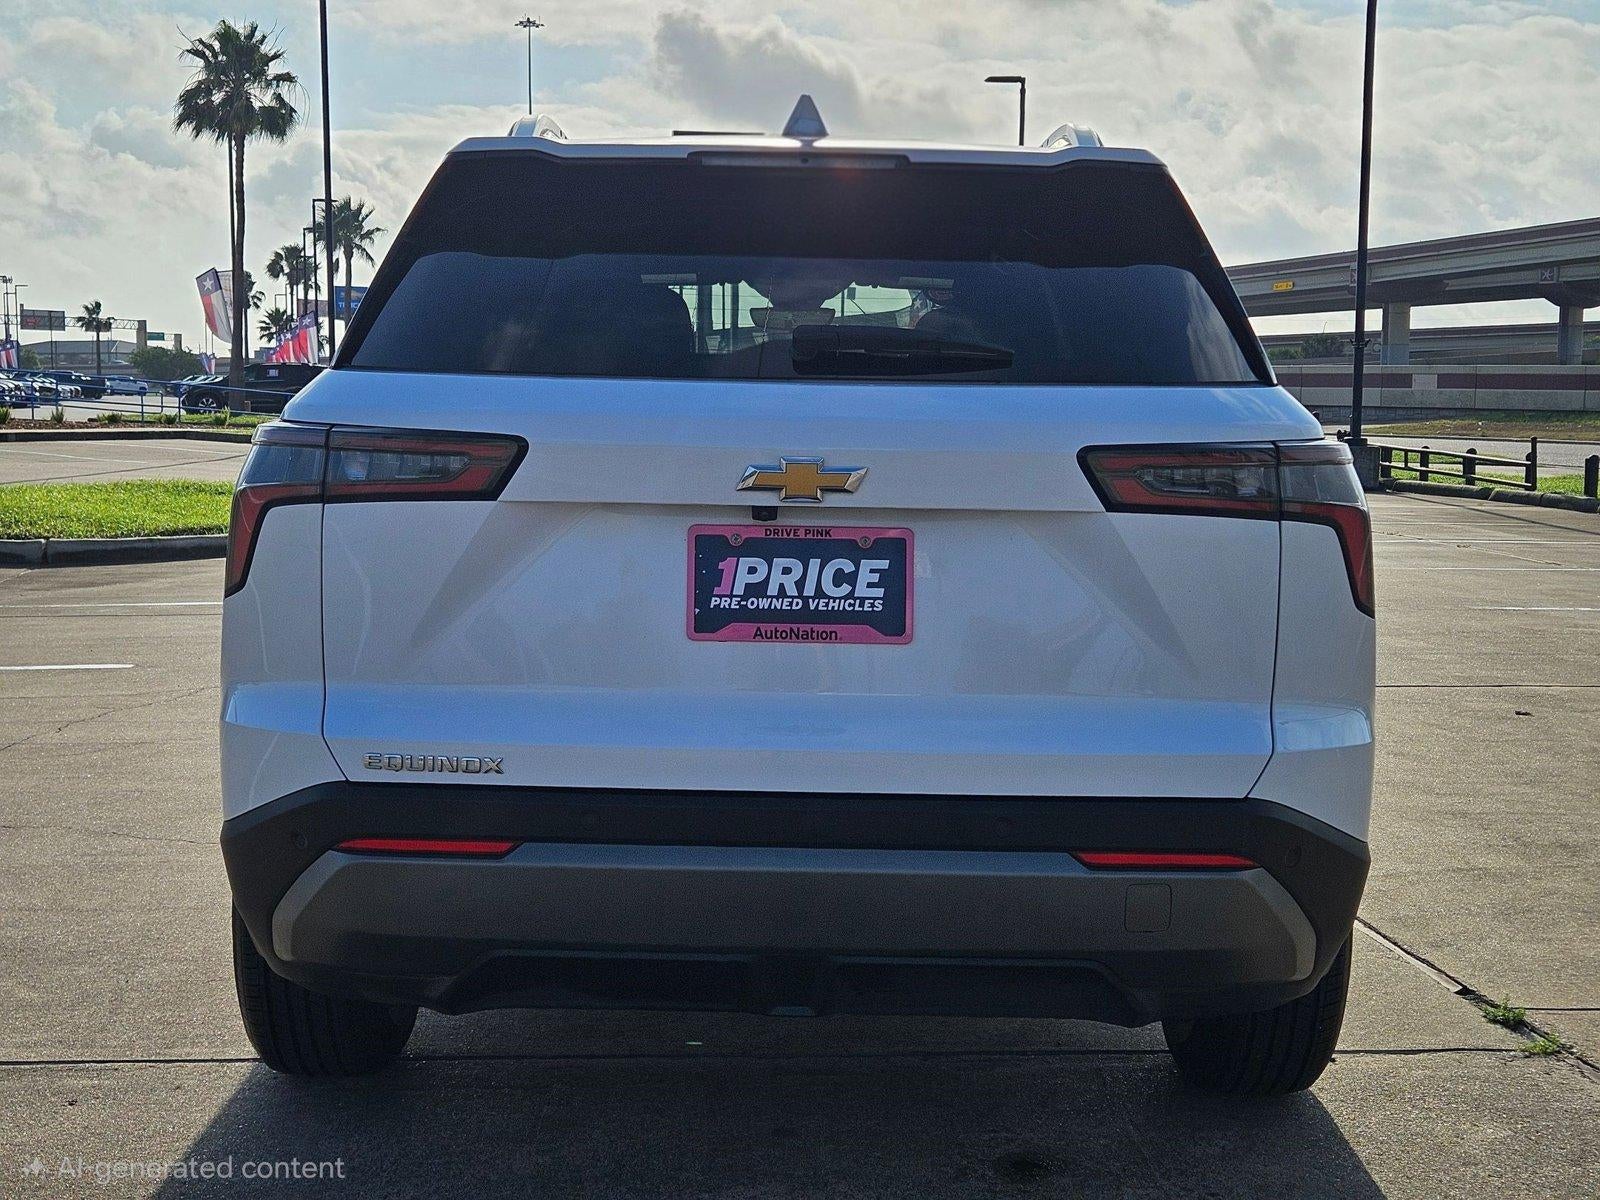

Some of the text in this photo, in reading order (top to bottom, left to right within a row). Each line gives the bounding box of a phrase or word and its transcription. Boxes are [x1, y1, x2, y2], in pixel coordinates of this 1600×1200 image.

[764, 528, 832, 538] DRIVE PINK
[713, 557, 890, 598] 1PRICE
[710, 597, 884, 612] PRE-OWNED VEHICLES
[753, 626, 838, 641] AutoNation
[363, 752, 504, 774] EQUINOX
